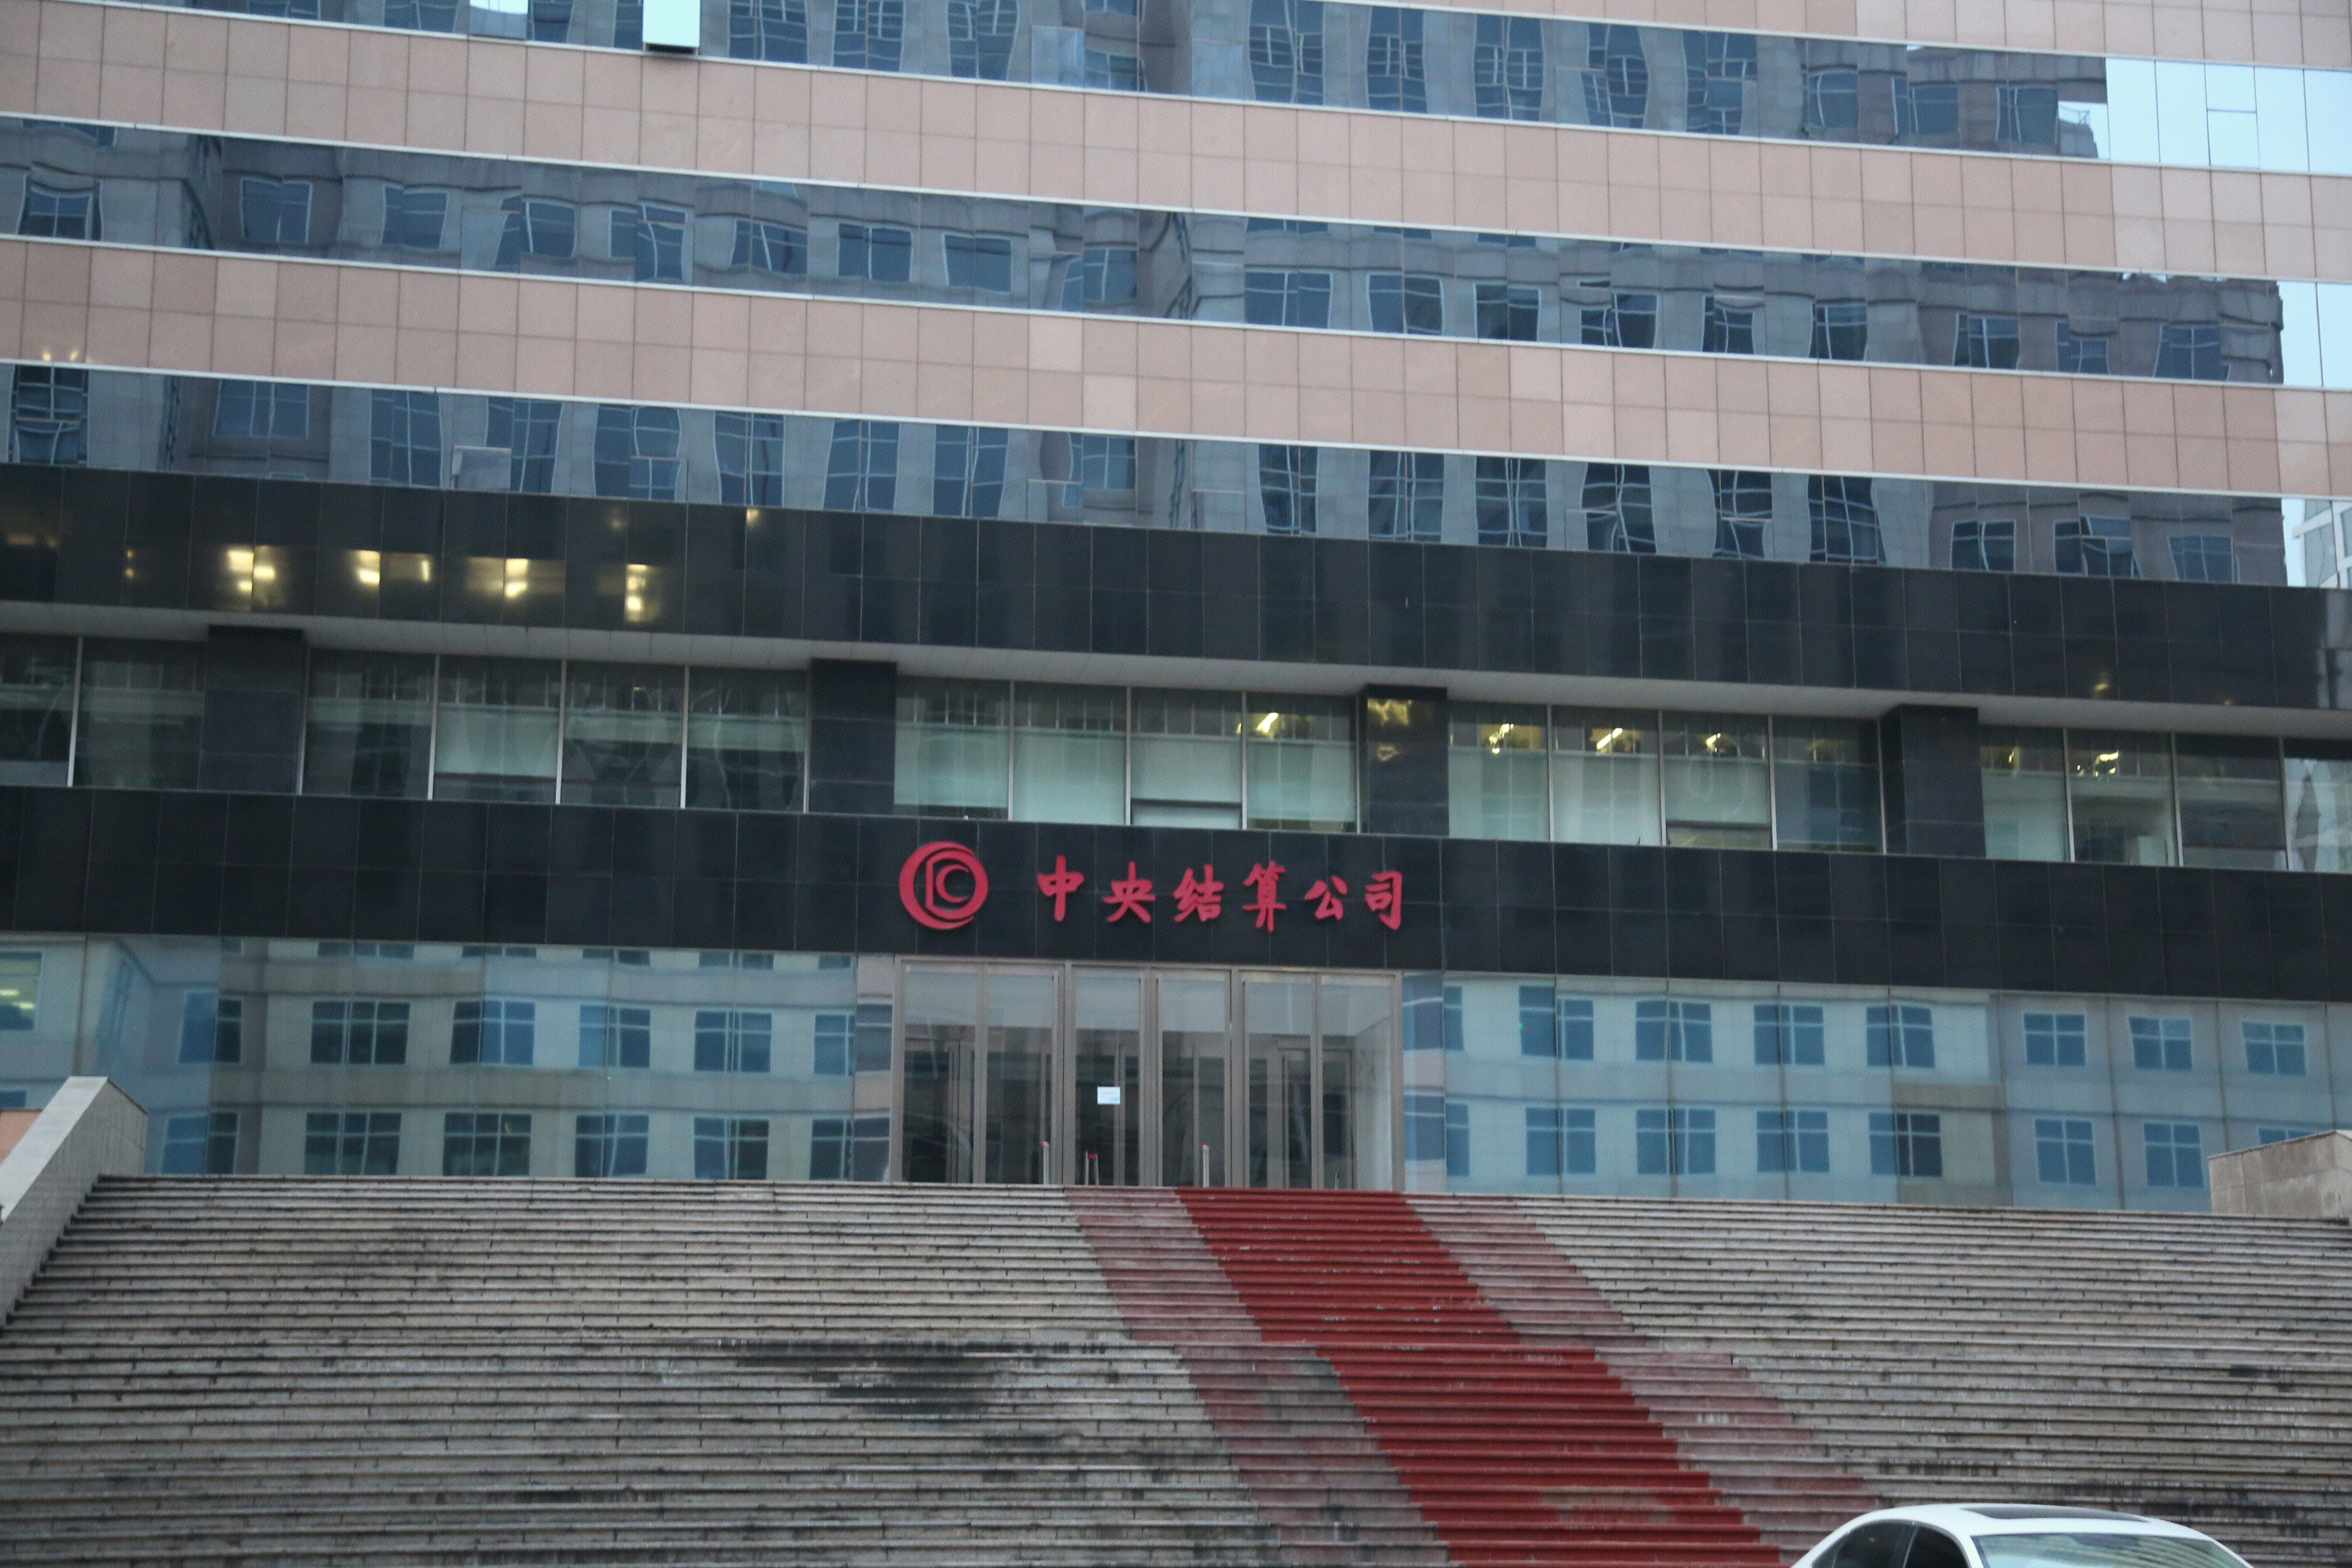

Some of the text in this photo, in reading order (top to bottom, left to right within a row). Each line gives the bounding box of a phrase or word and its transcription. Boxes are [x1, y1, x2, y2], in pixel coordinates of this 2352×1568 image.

[1037, 856, 1403, 932] 中央结算公司
